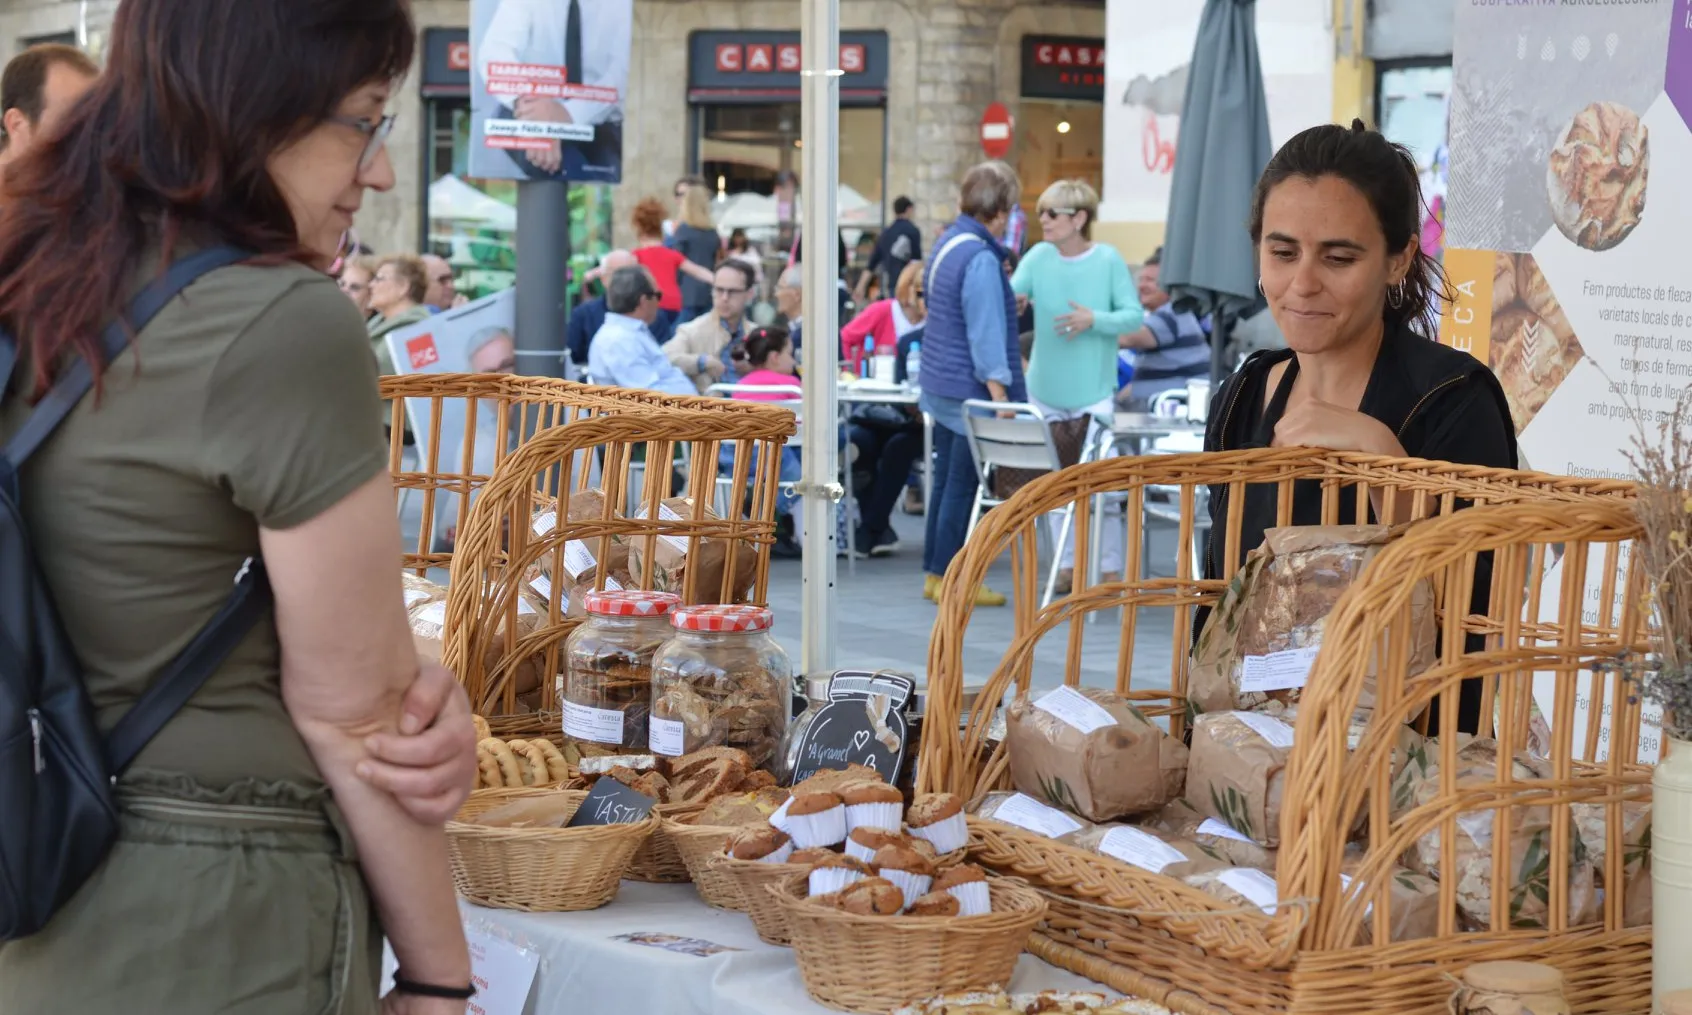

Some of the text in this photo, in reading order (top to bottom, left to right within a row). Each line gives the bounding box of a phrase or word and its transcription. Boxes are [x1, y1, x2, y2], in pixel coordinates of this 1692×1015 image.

[719, 47, 859, 69] CASS
[1583, 280, 1692, 303] Fem productes de fleca
[1599, 305, 1639, 324] varietats
[1642, 308, 1669, 326] locals
[1671, 311, 1683, 328] de
[1651, 358, 1663, 374] de
[1666, 359, 1692, 378] ferme
[1650, 381, 1662, 399] de
[1588, 401, 1608, 417] amb
[1609, 404, 1653, 420] projectes
